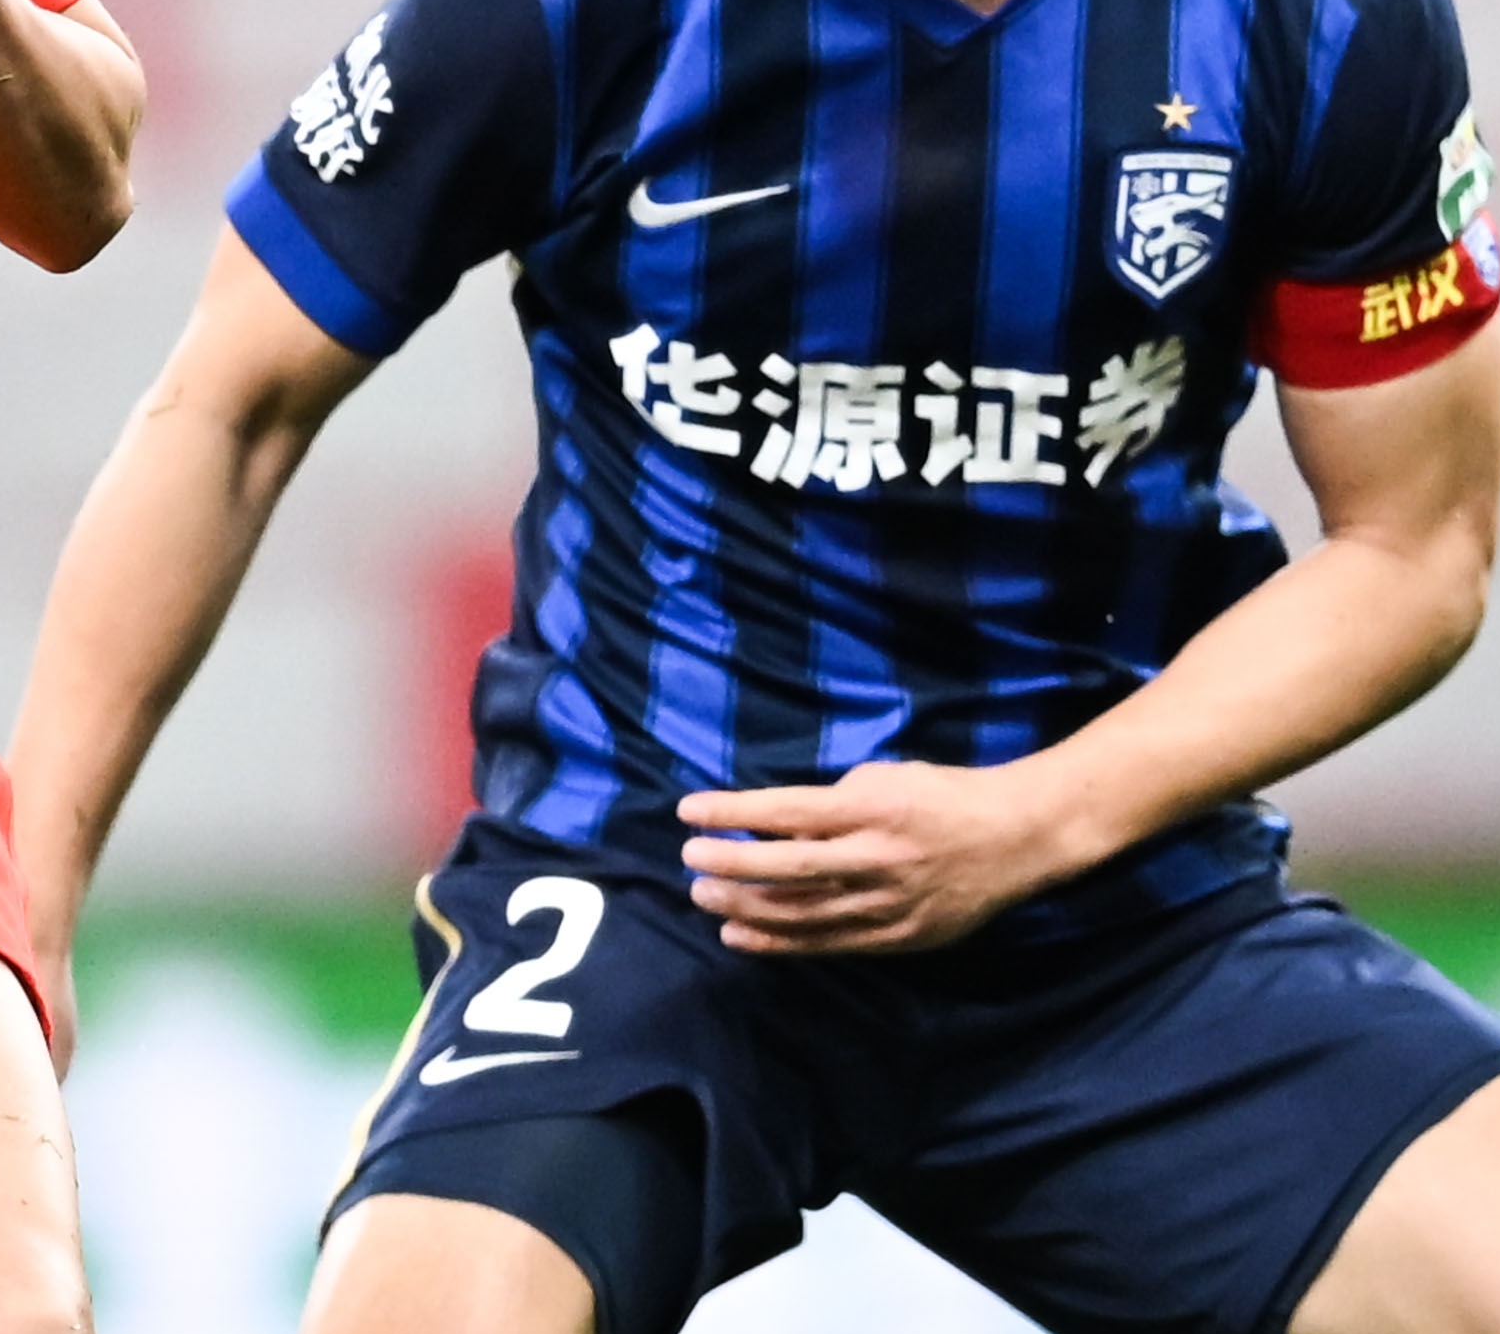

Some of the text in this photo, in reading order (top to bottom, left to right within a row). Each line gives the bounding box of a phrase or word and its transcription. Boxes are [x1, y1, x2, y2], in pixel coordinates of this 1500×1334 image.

[1359, 247, 1464, 344] 武汉
[609, 322, 1186, 492] 华源证券
[463, 875, 605, 1039] 2
